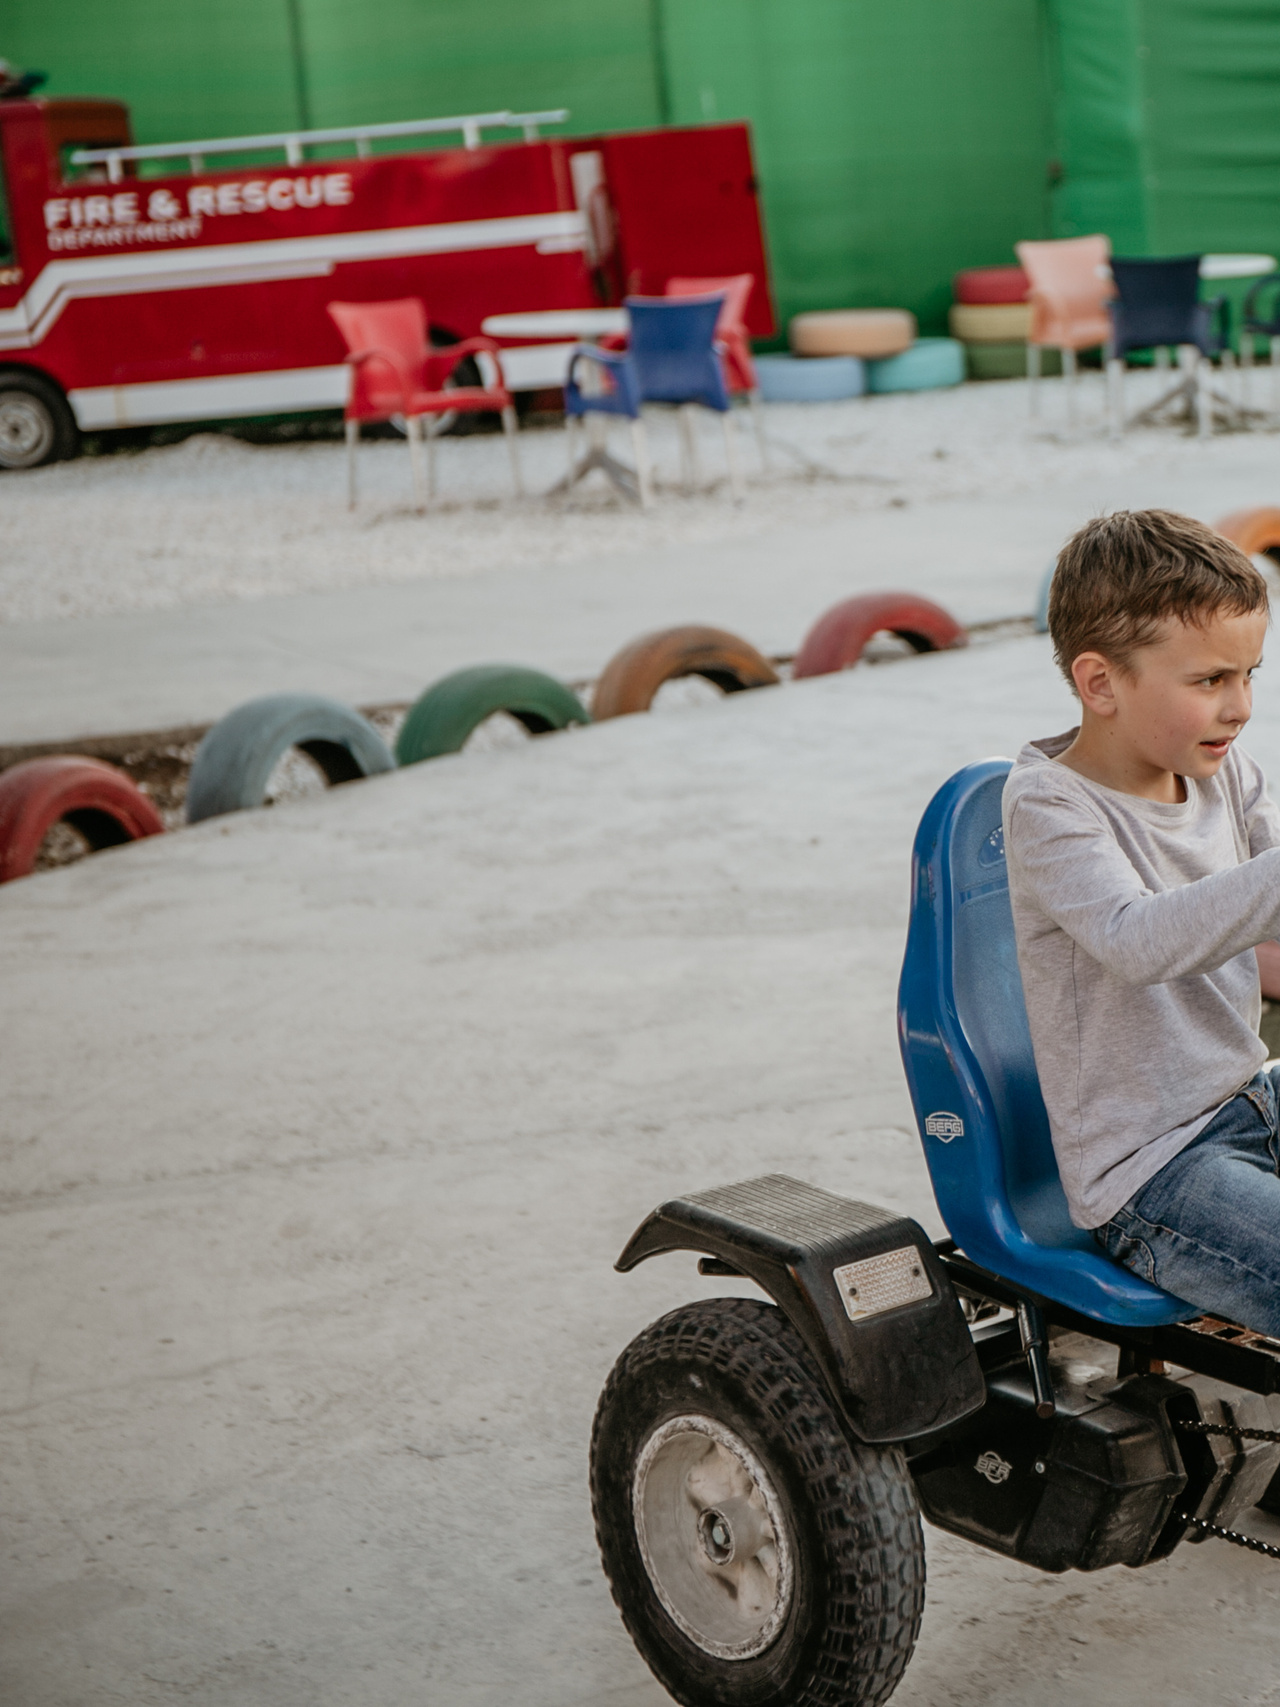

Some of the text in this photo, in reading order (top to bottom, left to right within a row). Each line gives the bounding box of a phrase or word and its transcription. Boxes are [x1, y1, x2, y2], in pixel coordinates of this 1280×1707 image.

[43, 172, 353, 230] FIRE & RESCUE
[47, 216, 203, 251] DEPARTMENT
[927, 1121, 961, 1133] BERG
